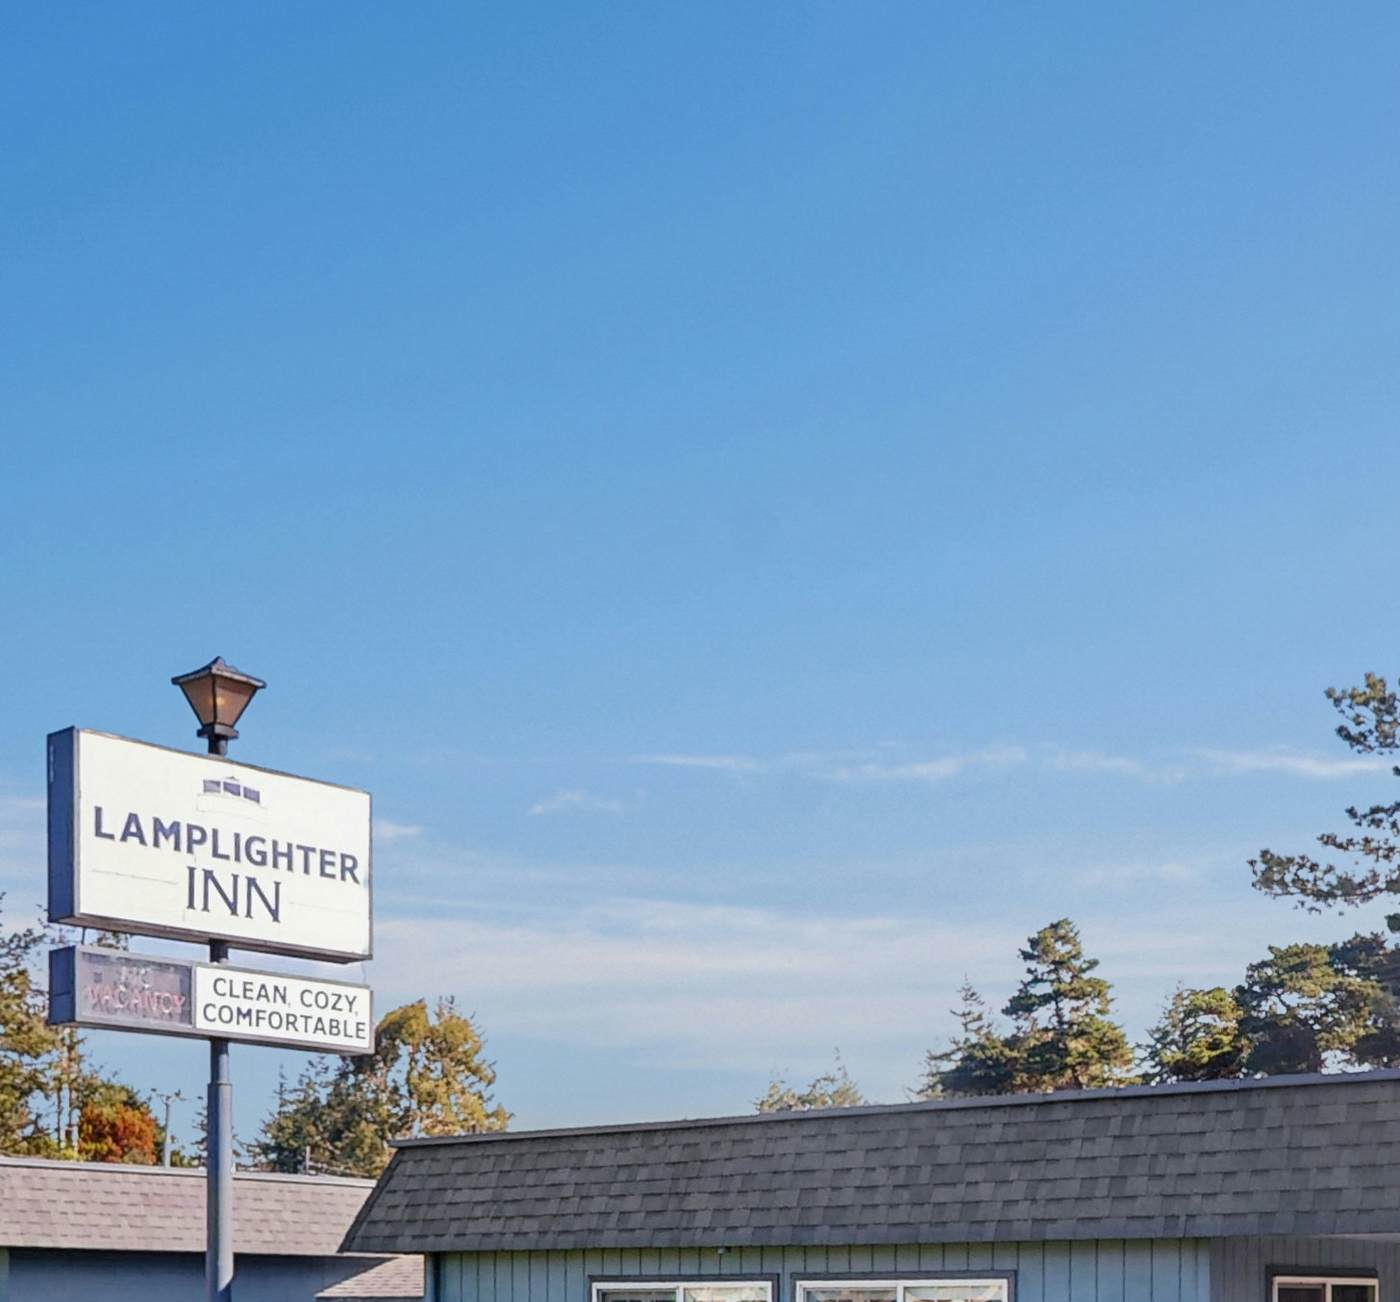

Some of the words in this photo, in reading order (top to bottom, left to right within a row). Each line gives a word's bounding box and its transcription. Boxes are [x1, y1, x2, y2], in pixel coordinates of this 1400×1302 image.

[93, 805, 361, 885] LAMPLIGHTER
[185, 865, 282, 923] INN
[202, 1002, 367, 1040] COMFORTABLE
